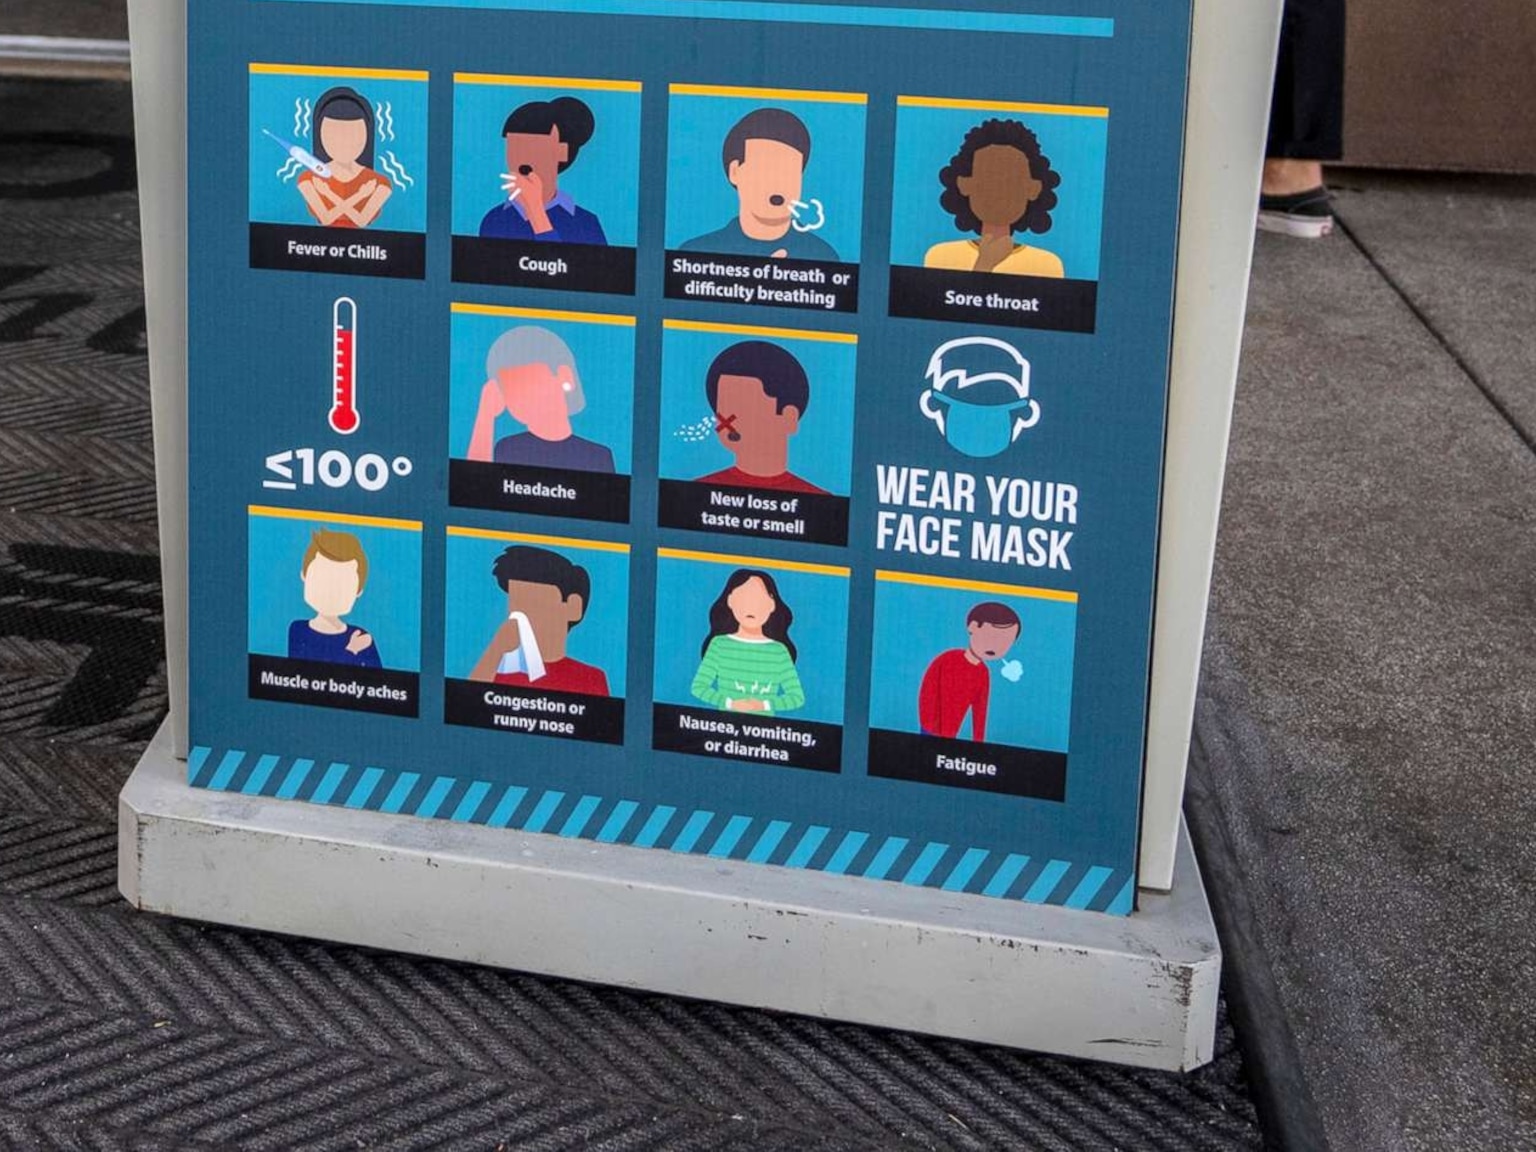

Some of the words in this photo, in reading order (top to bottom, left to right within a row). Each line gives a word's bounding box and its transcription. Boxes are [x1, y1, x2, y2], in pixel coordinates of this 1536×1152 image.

[288, 241, 326, 256] Fever
[330, 247, 345, 256] or
[348, 245, 386, 260] Chills
[519, 257, 567, 275] Cough
[673, 259, 750, 277] Shortness
[753, 265, 770, 278] of
[773, 265, 825, 283] breath
[833, 274, 850, 285] or
[685, 280, 754, 302] difficulty
[758, 285, 835, 308] breathing
[945, 291, 982, 306] Sore
[986, 294, 1038, 311] throat
[504, 480, 576, 499] Headache
[877, 465, 975, 512] WEAR
[986, 476, 1078, 524] YOUR
[711, 492, 744, 507] New
[748, 495, 777, 510] loss
[781, 499, 798, 512] of
[702, 512, 740, 527] taste
[743, 518, 760, 529] or
[763, 520, 804, 534] smell
[877, 511, 961, 557] FACE
[971, 521, 1073, 570] MASK
[262, 672, 308, 688] Muscle
[312, 680, 326, 690] or
[330, 679, 364, 698] body
[367, 685, 406, 700] aches
[484, 692, 565, 713] Congestion
[569, 704, 585, 714] or
[495, 715, 536, 731] runny
[540, 720, 574, 733] nose
[680, 715, 739, 736] Nausea,
[743, 726, 816, 746] vomiting,
[705, 741, 721, 751] or
[724, 741, 788, 760] diarrhea
[937, 755, 996, 775] Fatigue
